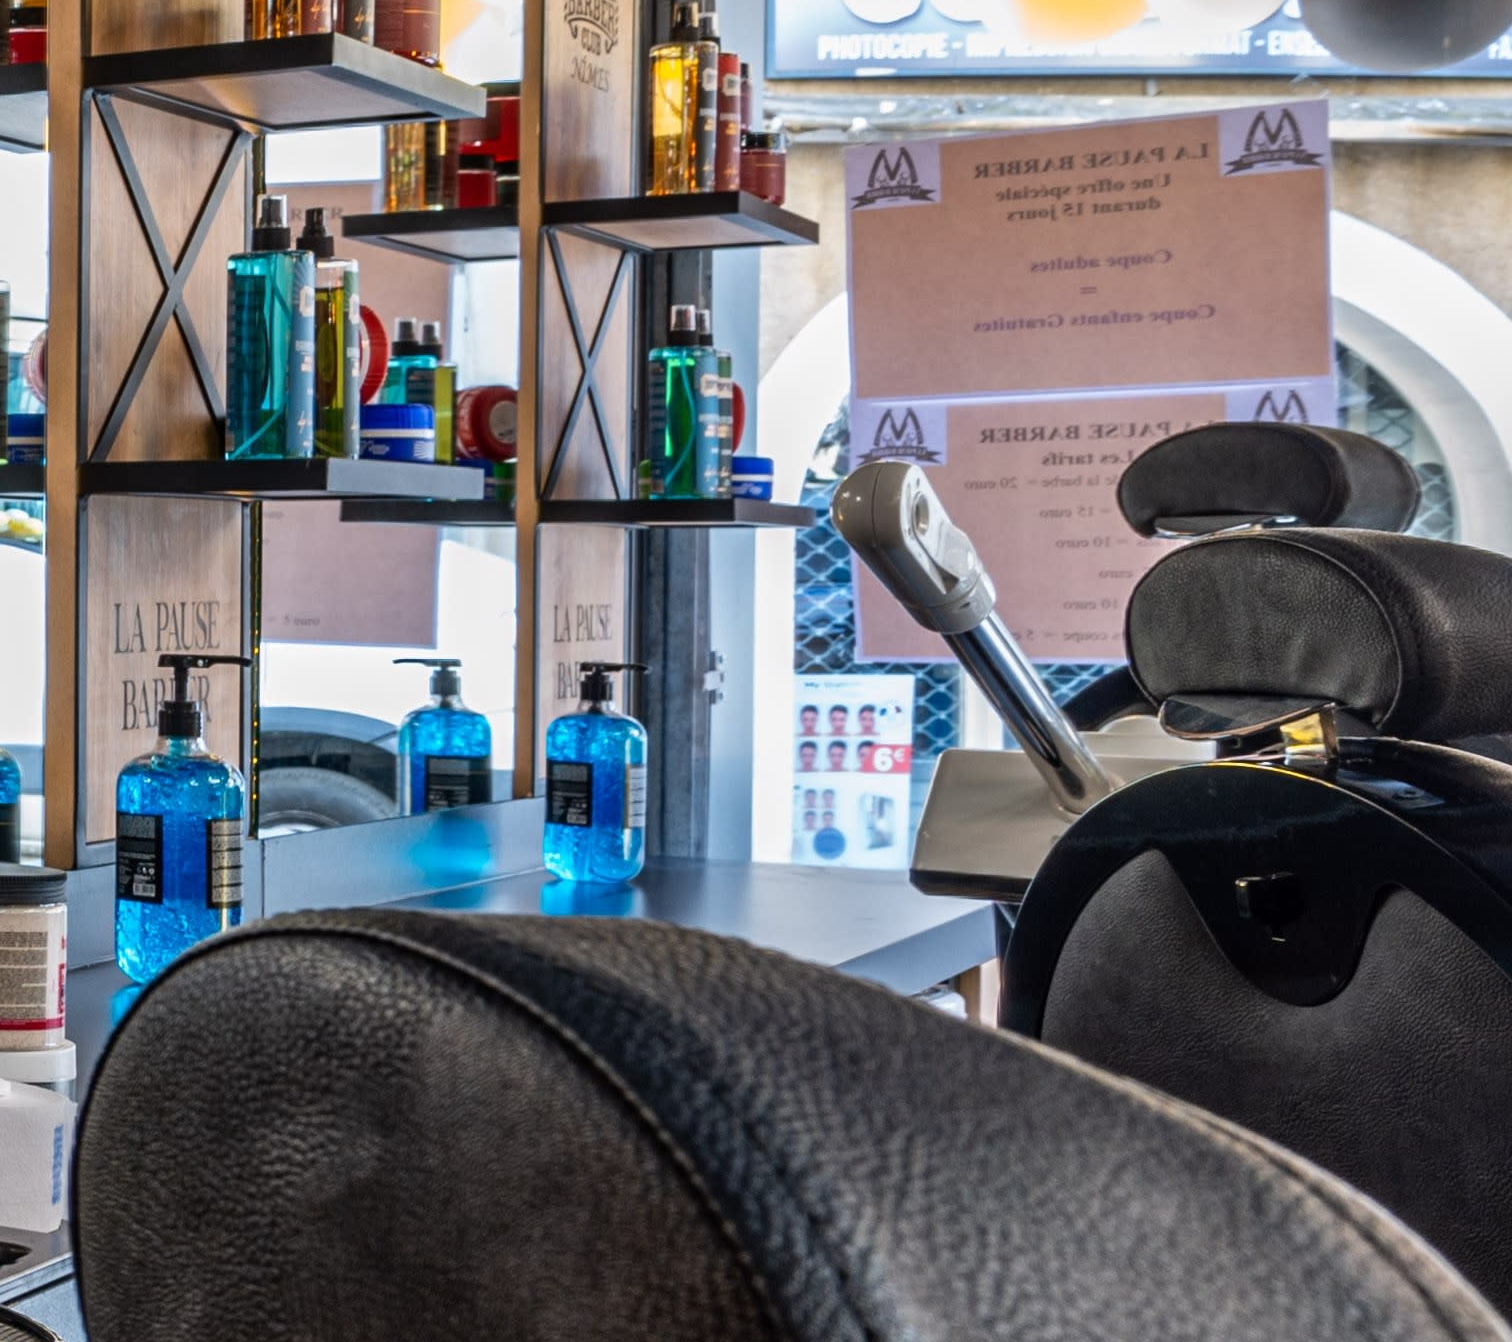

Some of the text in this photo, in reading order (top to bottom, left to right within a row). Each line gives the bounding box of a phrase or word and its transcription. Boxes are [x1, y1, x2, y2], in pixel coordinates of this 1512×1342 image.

[816, 34, 949, 60] PHOTOCOPIE
[114, 600, 221, 655] LA PAUSE
[553, 603, 613, 644] LA PAUSE
